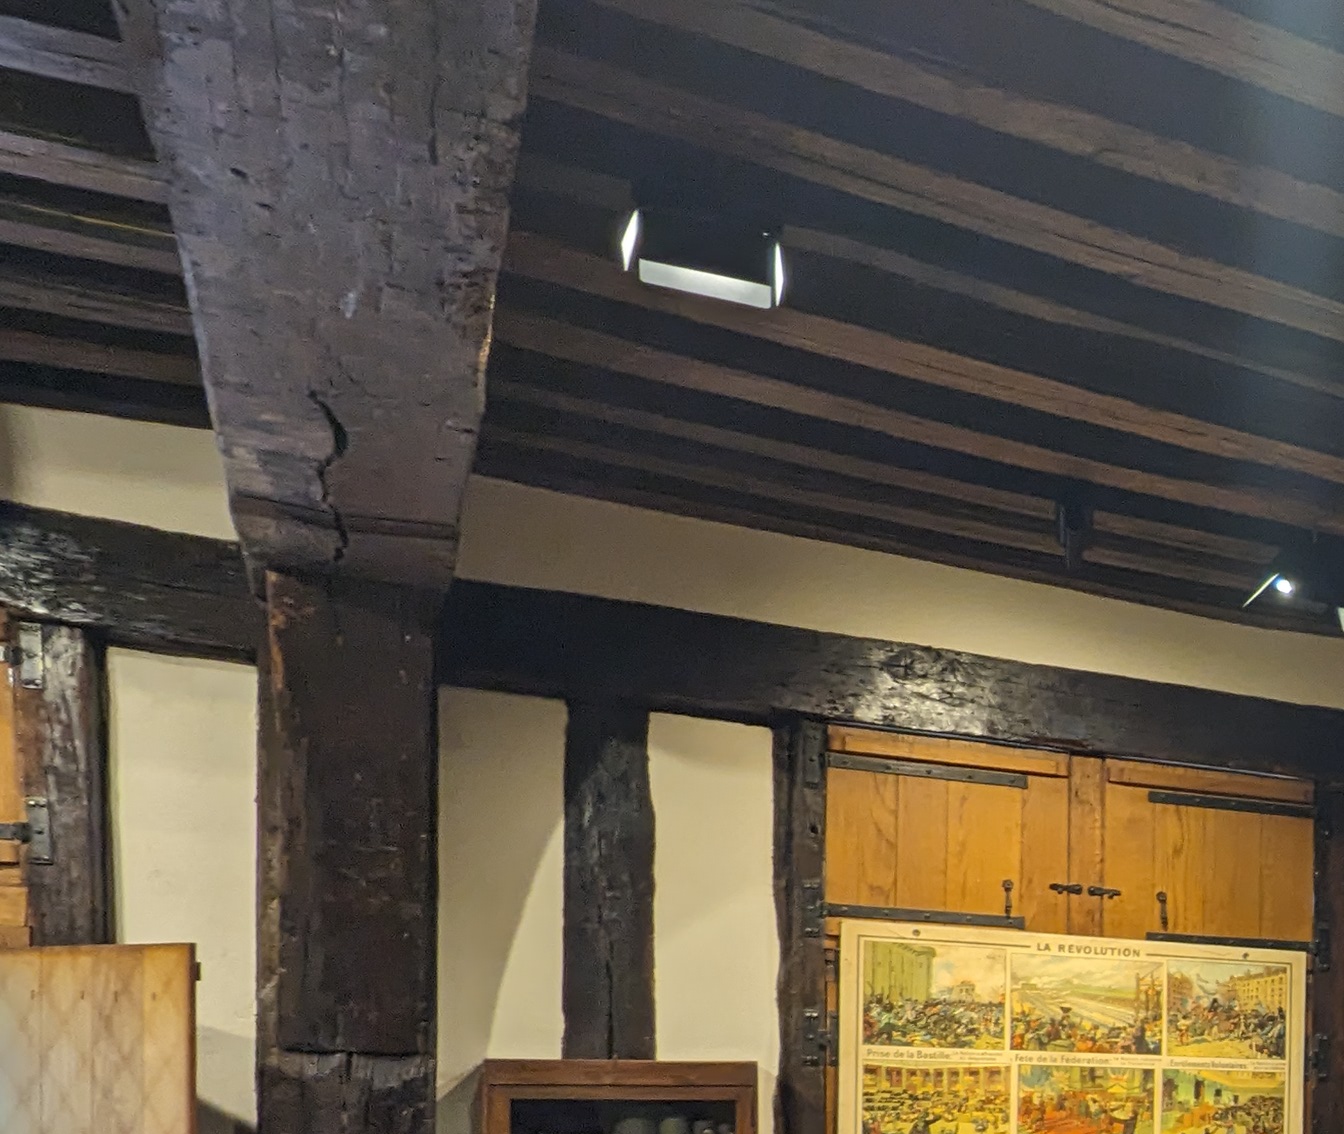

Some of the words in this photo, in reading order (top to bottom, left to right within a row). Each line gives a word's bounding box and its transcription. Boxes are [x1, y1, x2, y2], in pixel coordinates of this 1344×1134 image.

[1036, 942, 1052, 952] LA
[866, 1048, 891, 1058] Prise
[893, 1049, 905, 1059] de
[906, 1050, 915, 1059] la
[1036, 1054, 1048, 1063] de
